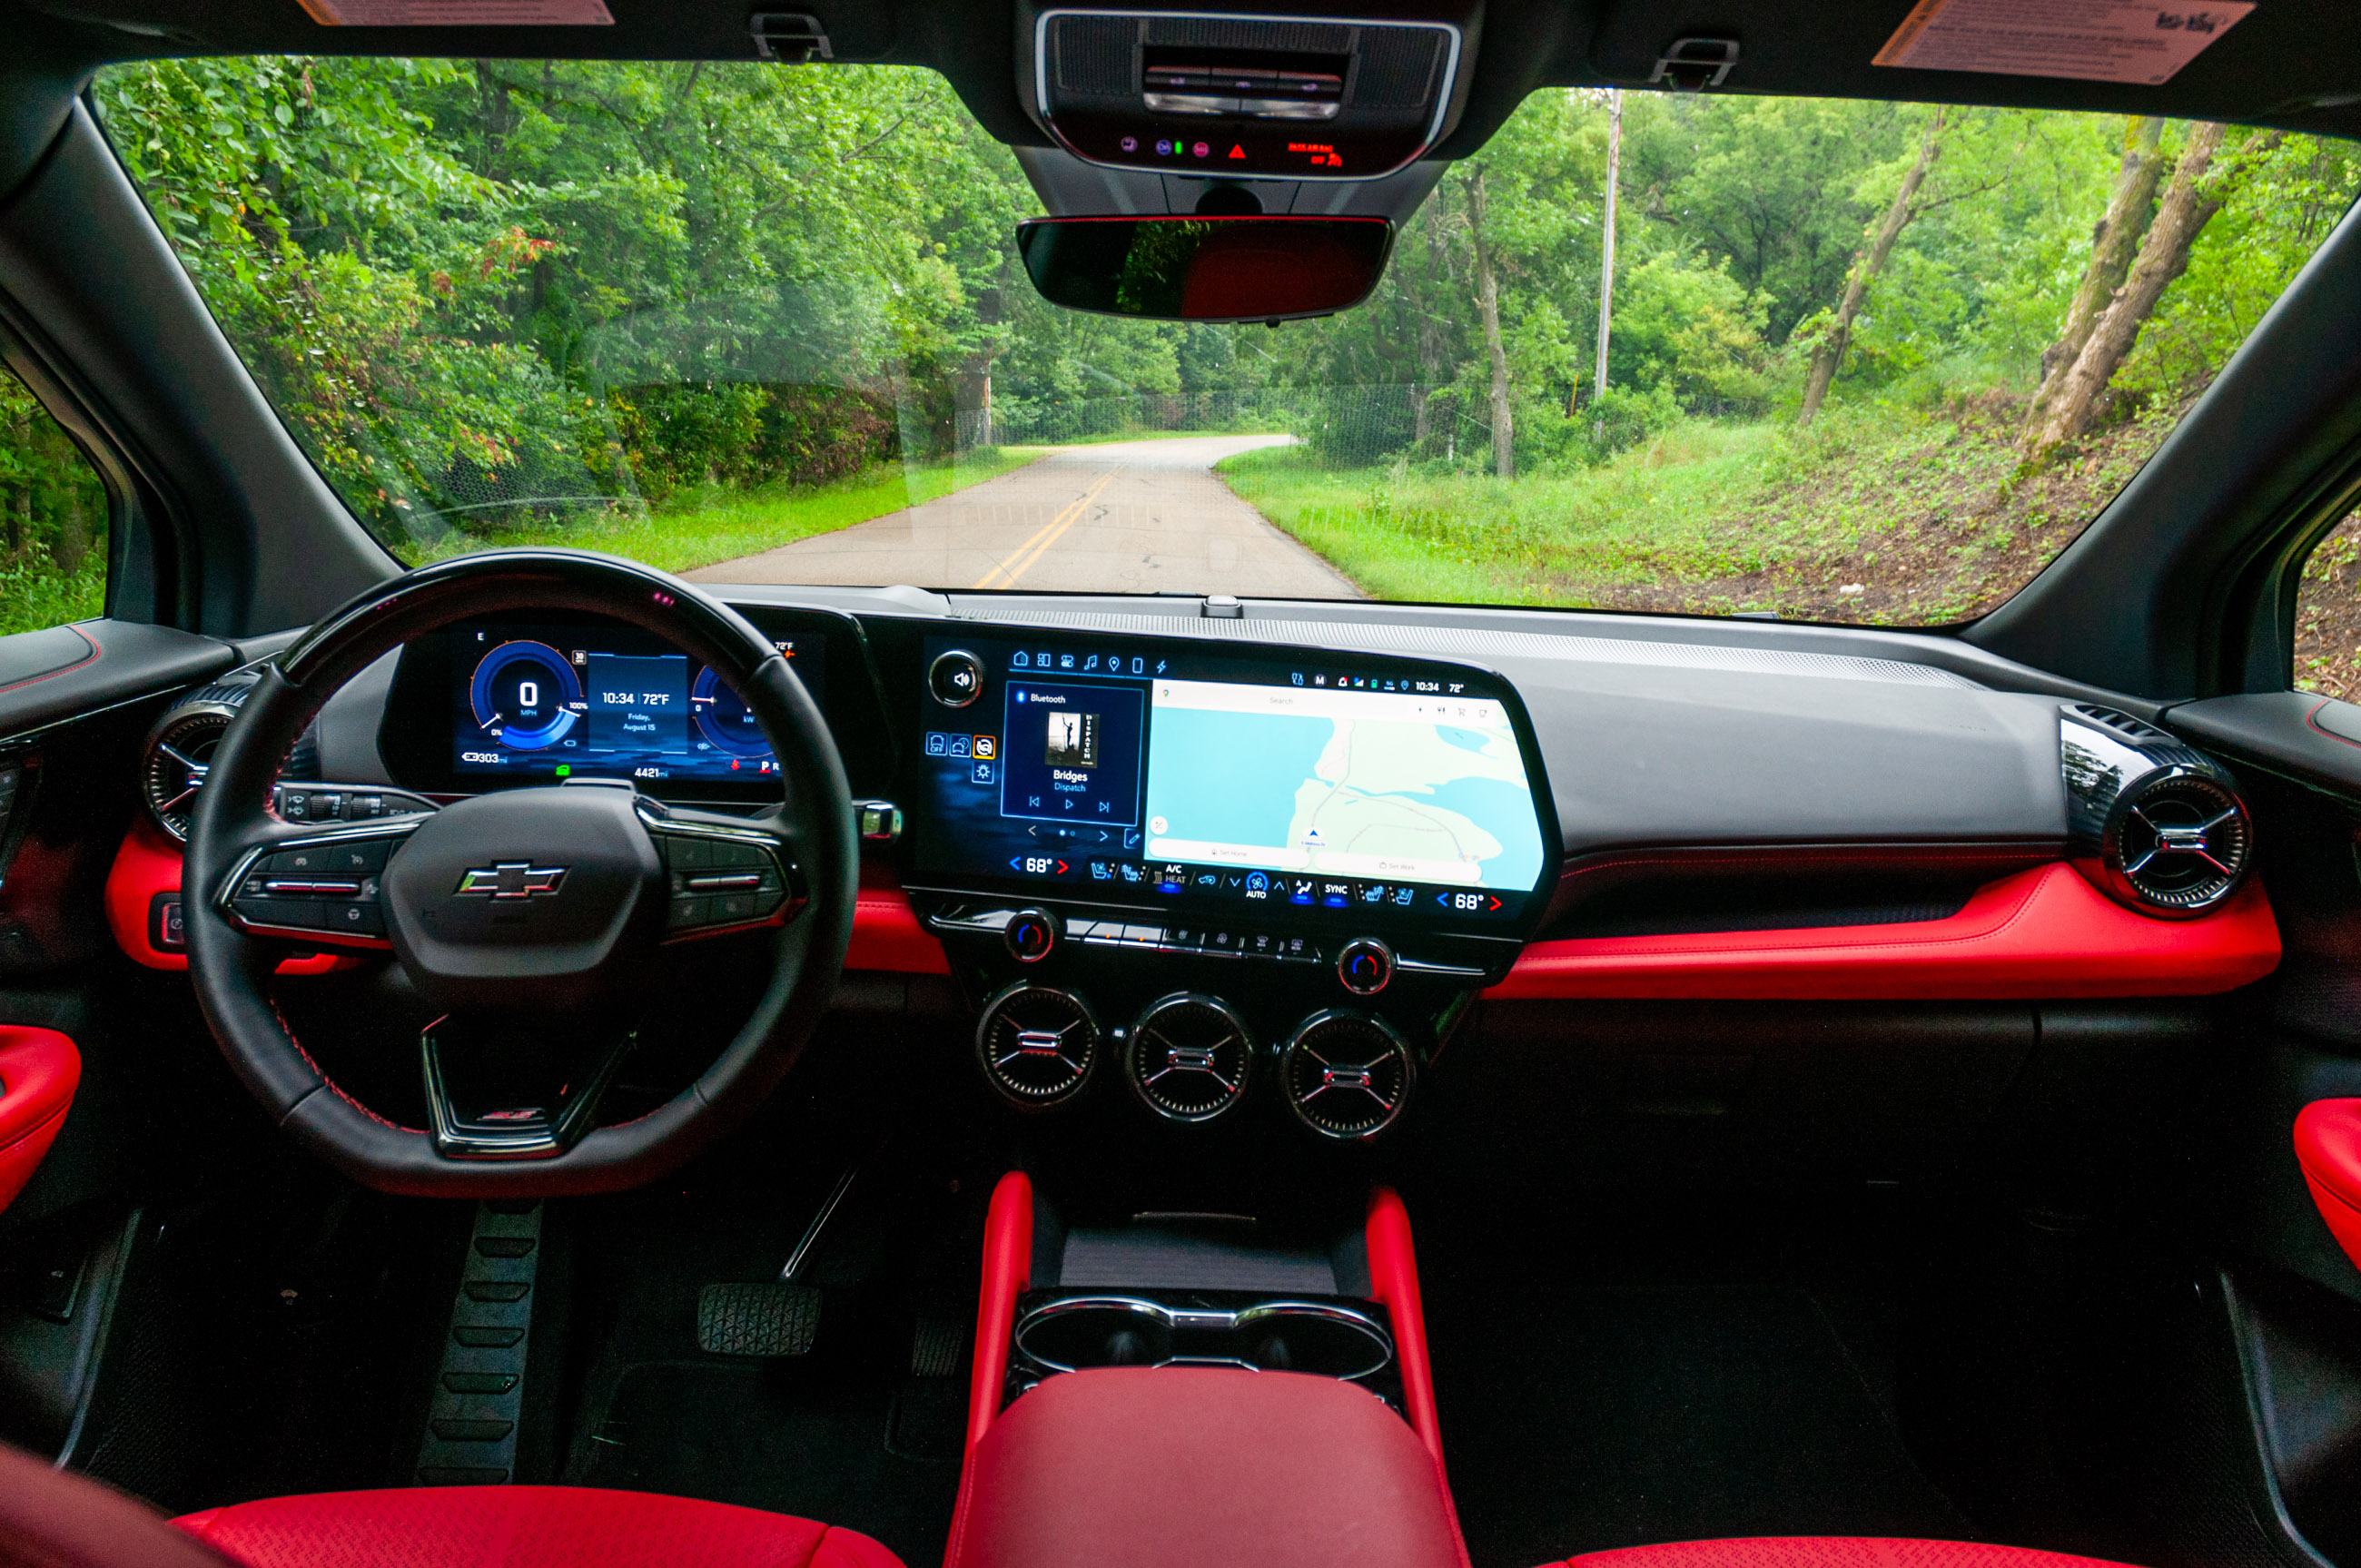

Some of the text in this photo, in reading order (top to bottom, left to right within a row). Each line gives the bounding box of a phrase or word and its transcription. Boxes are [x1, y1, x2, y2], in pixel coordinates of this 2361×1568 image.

[1289, 143, 1307, 152] PASS
[478, 633, 484, 641] E
[775, 642, 793, 650] 72°F
[575, 652, 585, 660] 30
[1416, 681, 1464, 693] 10:34 72°
[519, 682, 538, 706] 0
[602, 692, 670, 705] 10:34 72°F
[1031, 693, 1066, 704] Bluetooth
[1269, 696, 1293, 705] Search
[569, 702, 588, 710] 100%
[623, 724, 647, 732] August
[1084, 715, 1092, 759] DISPATCH
[478, 754, 499, 764] 303
[761, 761, 769, 770] P
[635, 768, 658, 778] 4421
[1053, 770, 1088, 784] Bridges
[1054, 783, 1086, 793] Dispatch
[1026, 858, 1052, 873] 68°
[1166, 864, 1182, 873] A/C
[1400, 863, 1415, 871] Work
[1166, 875, 1186, 883] HEAT
[1325, 883, 1348, 894] SYNC
[1246, 890, 1267, 899] AUTO
[1455, 893, 1484, 910] 68°
